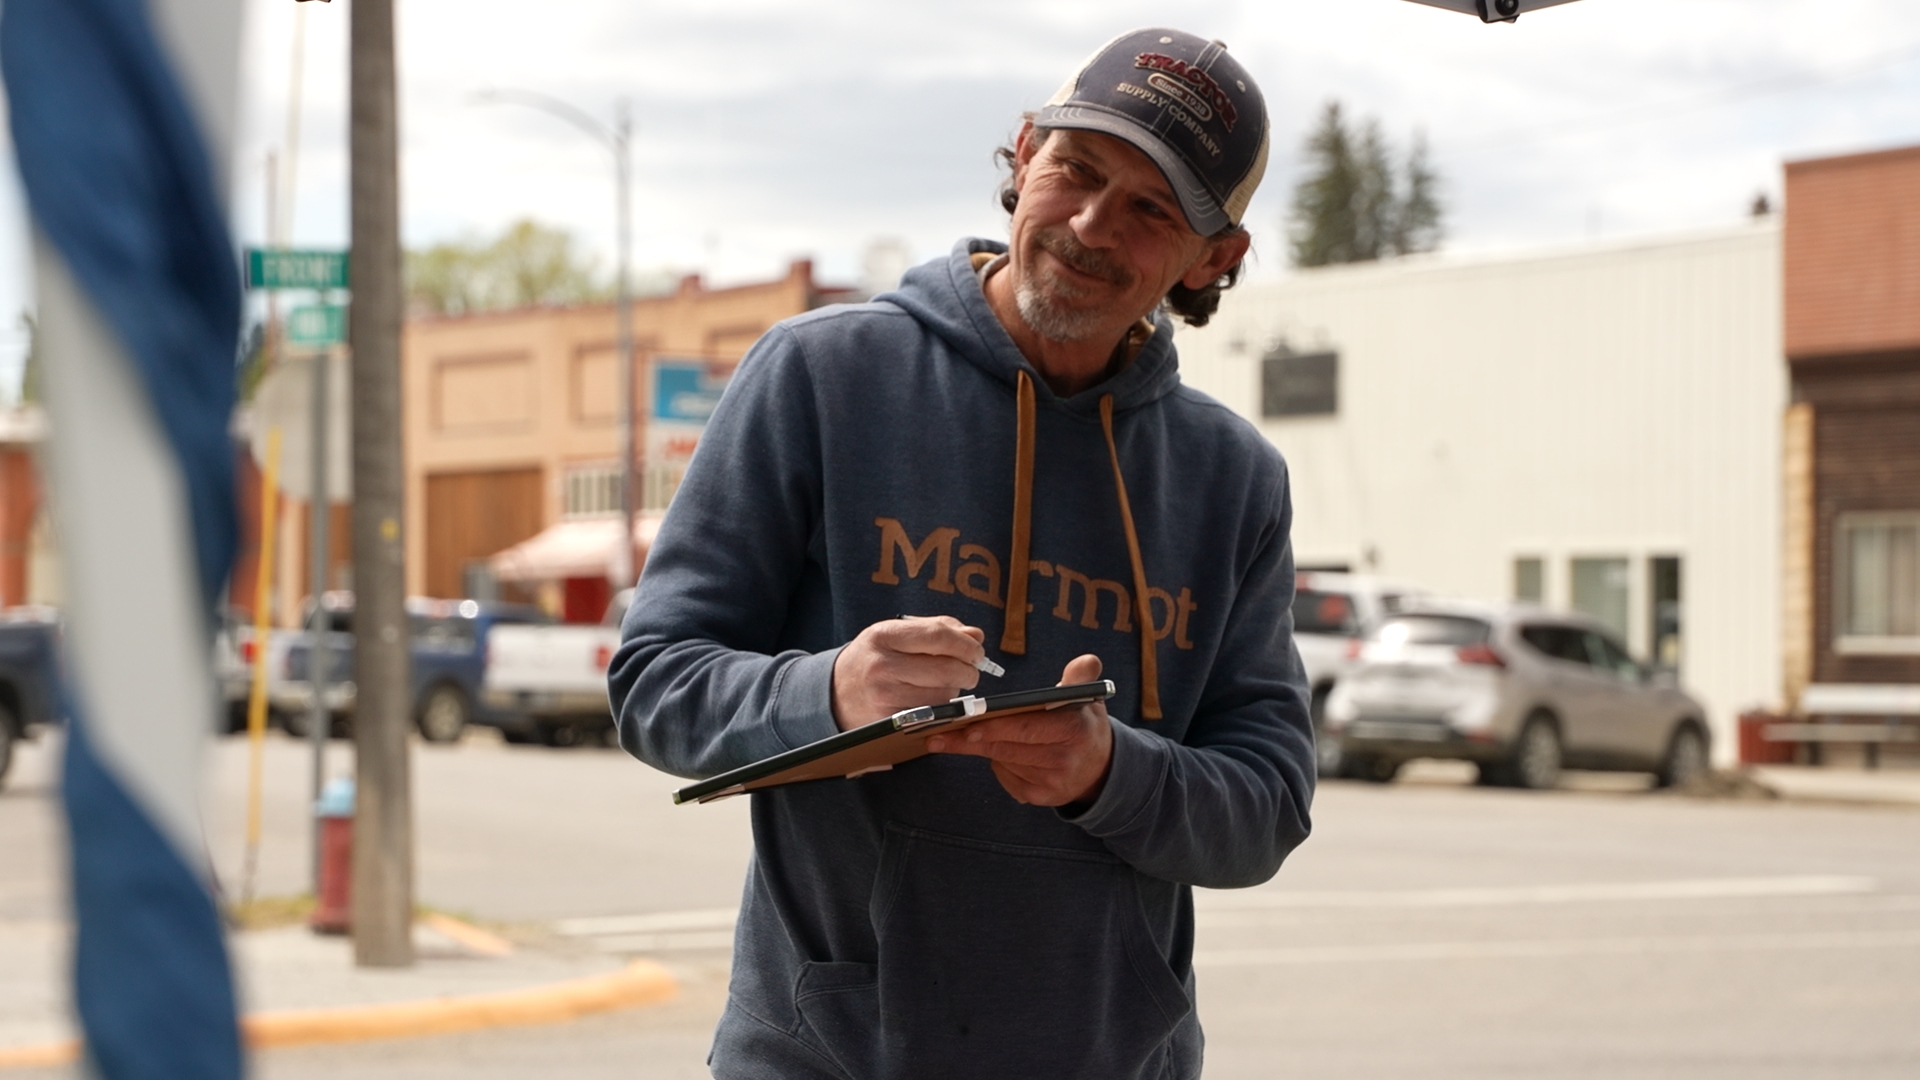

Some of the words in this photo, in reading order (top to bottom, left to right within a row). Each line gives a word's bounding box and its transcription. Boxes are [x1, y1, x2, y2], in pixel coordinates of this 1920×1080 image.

[1117, 82, 1168, 109] SUPPLY
[1168, 104, 1220, 157] COMPANY
[1134, 52, 1238, 133] TRACTOR
[1155, 78, 1183, 97] Since
[1184, 95, 1207, 115] 1938
